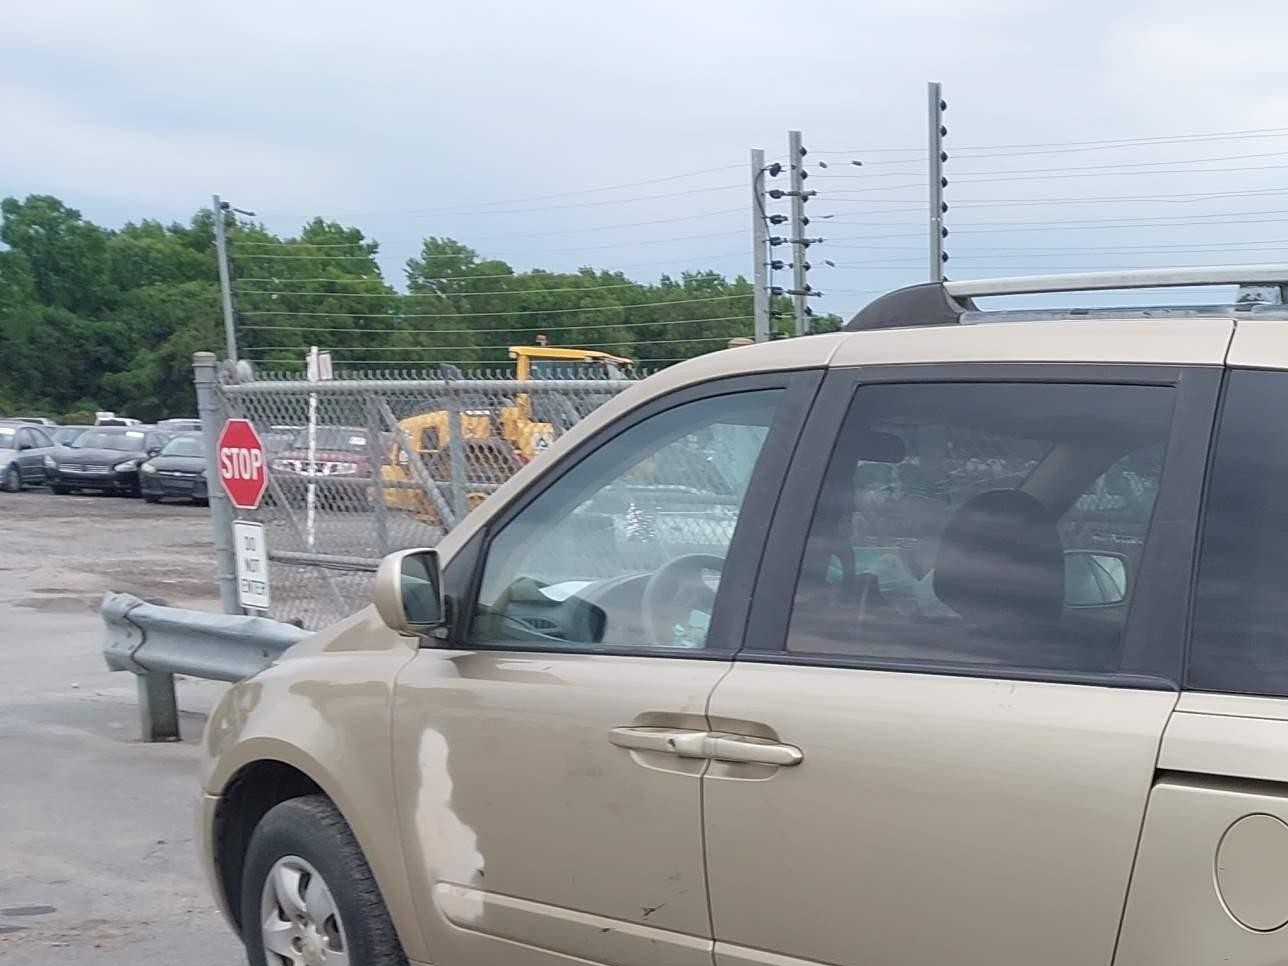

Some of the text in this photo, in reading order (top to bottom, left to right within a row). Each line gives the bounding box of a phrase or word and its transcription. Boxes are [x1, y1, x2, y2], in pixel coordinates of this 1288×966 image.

[220, 447, 262, 481] STOP
[243, 535, 257, 552] DO
[243, 557, 261, 573] NOT
[240, 578, 266, 596] ENTER
